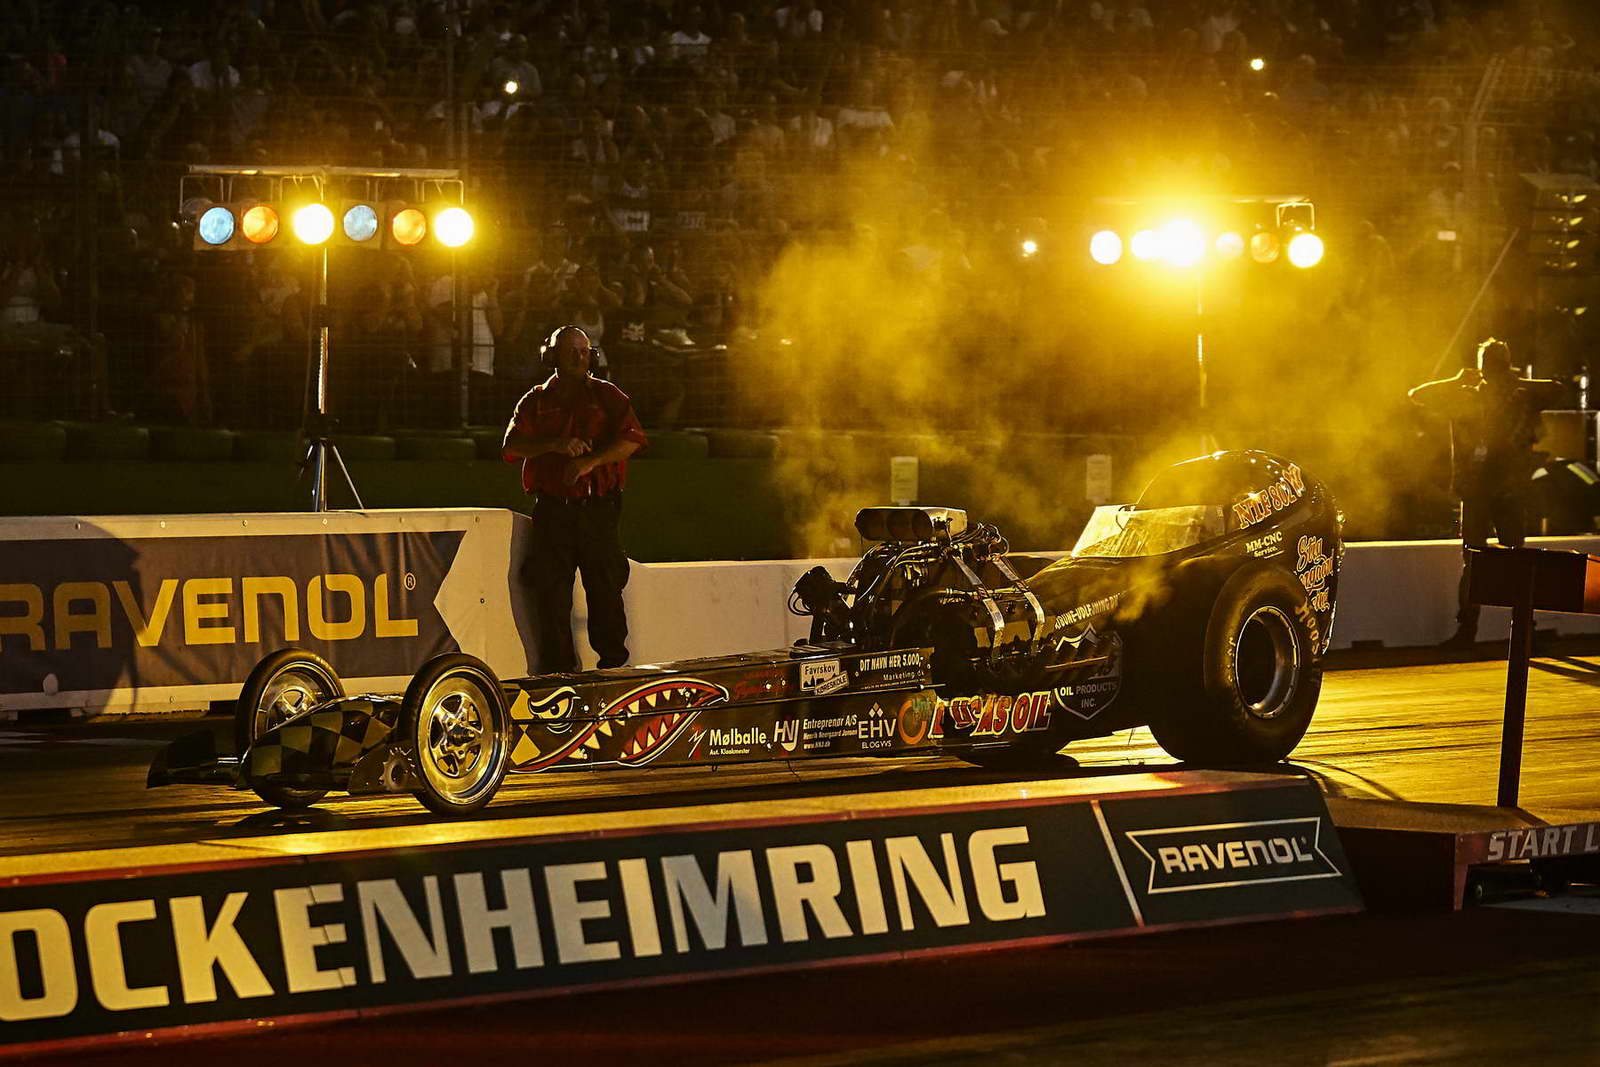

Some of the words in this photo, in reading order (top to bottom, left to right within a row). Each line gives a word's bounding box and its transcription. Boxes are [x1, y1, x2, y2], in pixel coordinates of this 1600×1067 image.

[1245, 531, 1283, 553] MM-CNC
[804, 664, 836, 675] Favrskov
[859, 658, 871, 672] DIT
[871, 656, 888, 670] NAVN
[888, 655, 901, 668] HER
[1059, 686, 1074, 697] OIL
[1075, 681, 1117, 695] PRODUCTS
[1011, 690, 1053, 734] OIL
[709, 727, 767, 747] Mølballe
[858, 718, 897, 739] EHV
[862, 741, 869, 749] EL
[869, 740, 880, 749] OG
[1487, 824, 1577, 862] START
